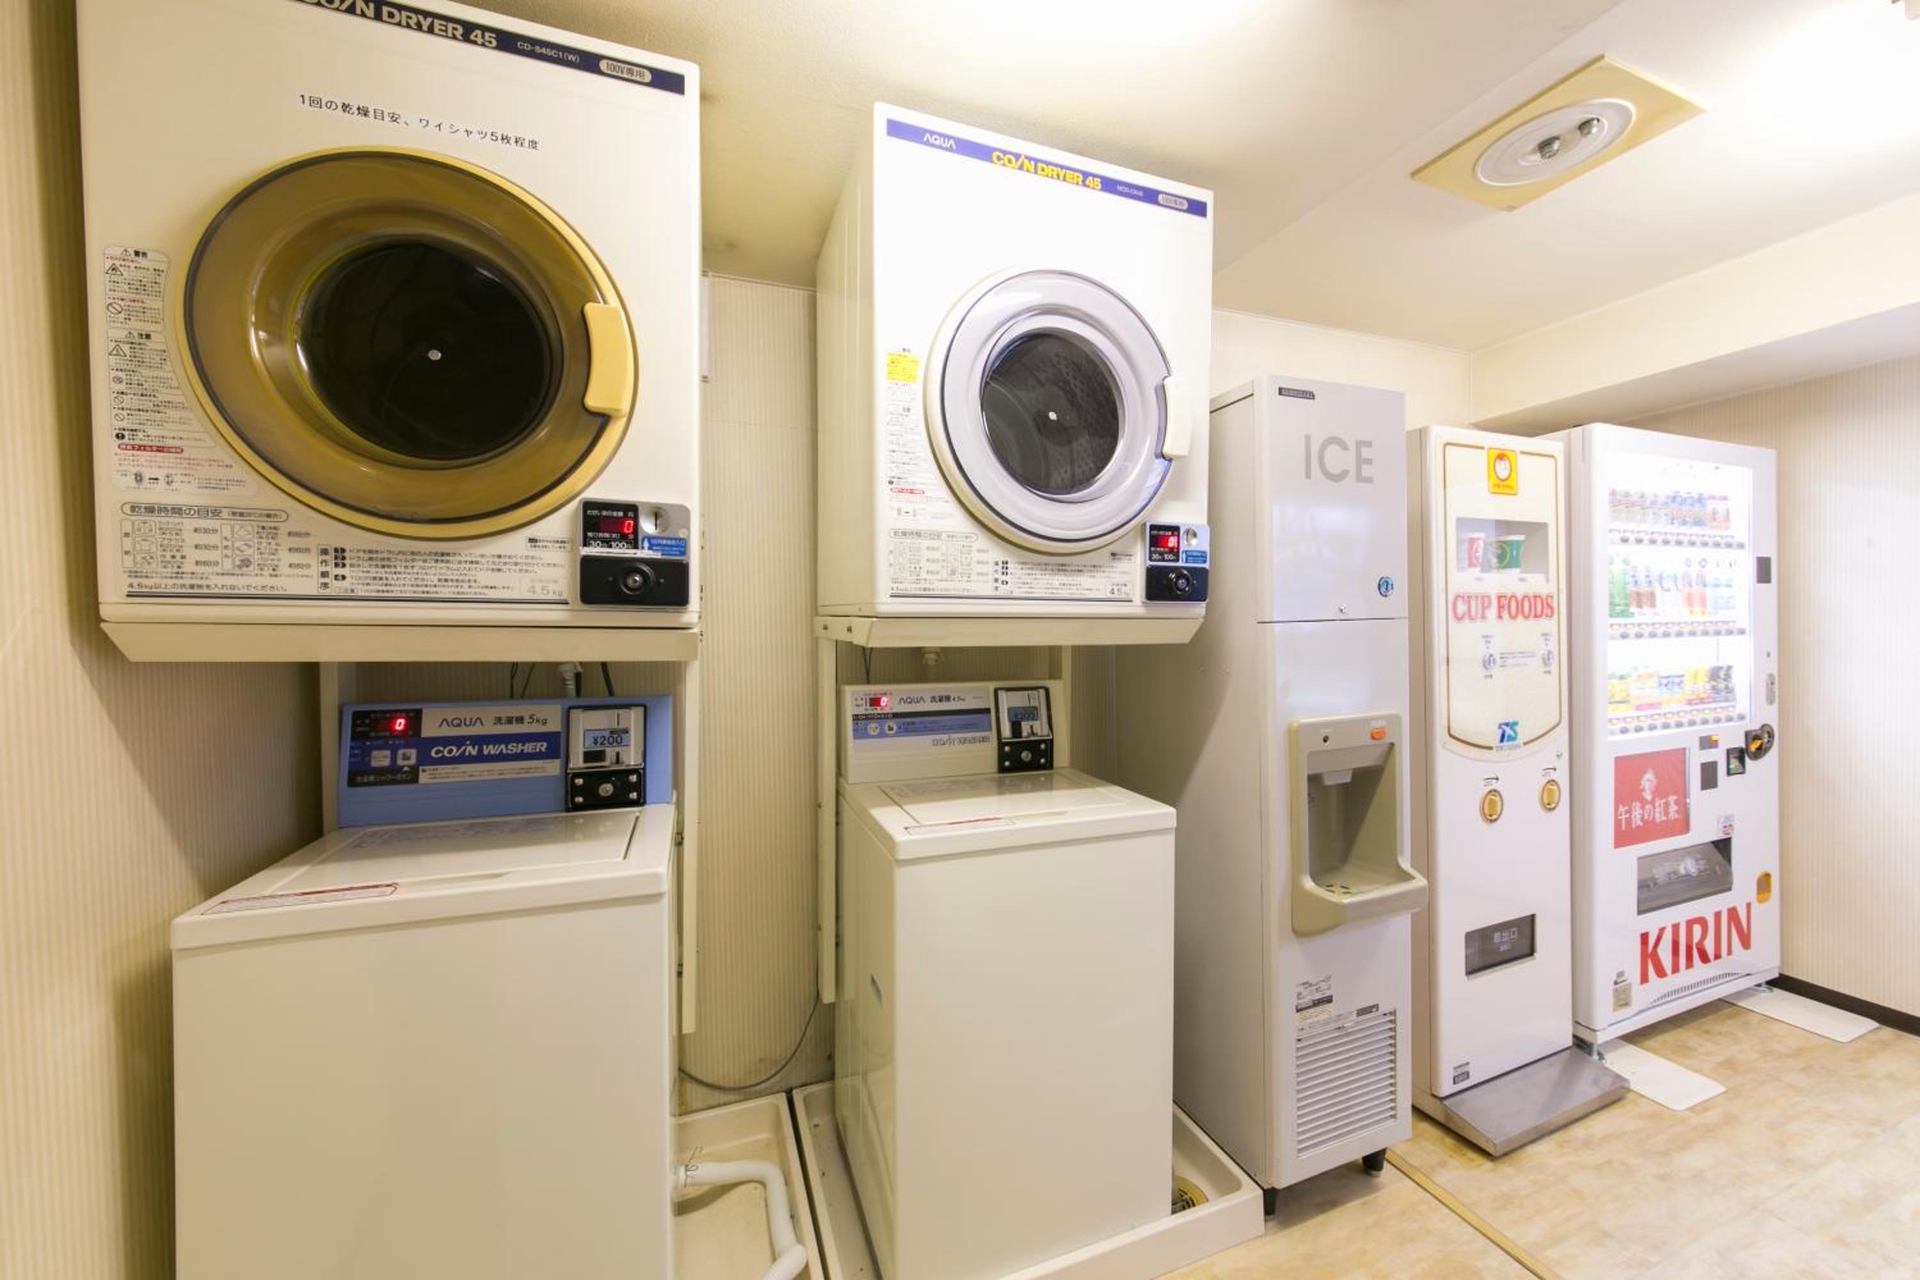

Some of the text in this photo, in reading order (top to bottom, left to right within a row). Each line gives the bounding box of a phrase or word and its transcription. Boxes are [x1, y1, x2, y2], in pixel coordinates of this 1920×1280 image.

[381, 5, 463, 40] DRYER
[469, 29, 497, 48] 45
[604, 61, 647, 80] 100V専用
[299, 93, 541, 151] 1回の乾燥目安、ワイシャツ5枚程度
[923, 132, 956, 150] AQUA
[991, 151, 1101, 191] COIN DRYER 45
[1304, 434, 1373, 483] ICE
[129, 504, 223, 518] 乾燥時間の目安
[623, 520, 635, 534] 0
[1453, 593, 1555, 622] CUP FOODS
[880, 697, 887, 706] 0
[899, 695, 926, 704] AQUA
[394, 718, 406, 731] 0
[438, 713, 548, 728] AQUA 洗濯機 5kg
[593, 734, 623, 746] ¥200
[430, 741, 548, 758] COIN WASHER
[1617, 795, 1680, 831] 午後の紅茶
[1640, 901, 1752, 986] KIRIN
